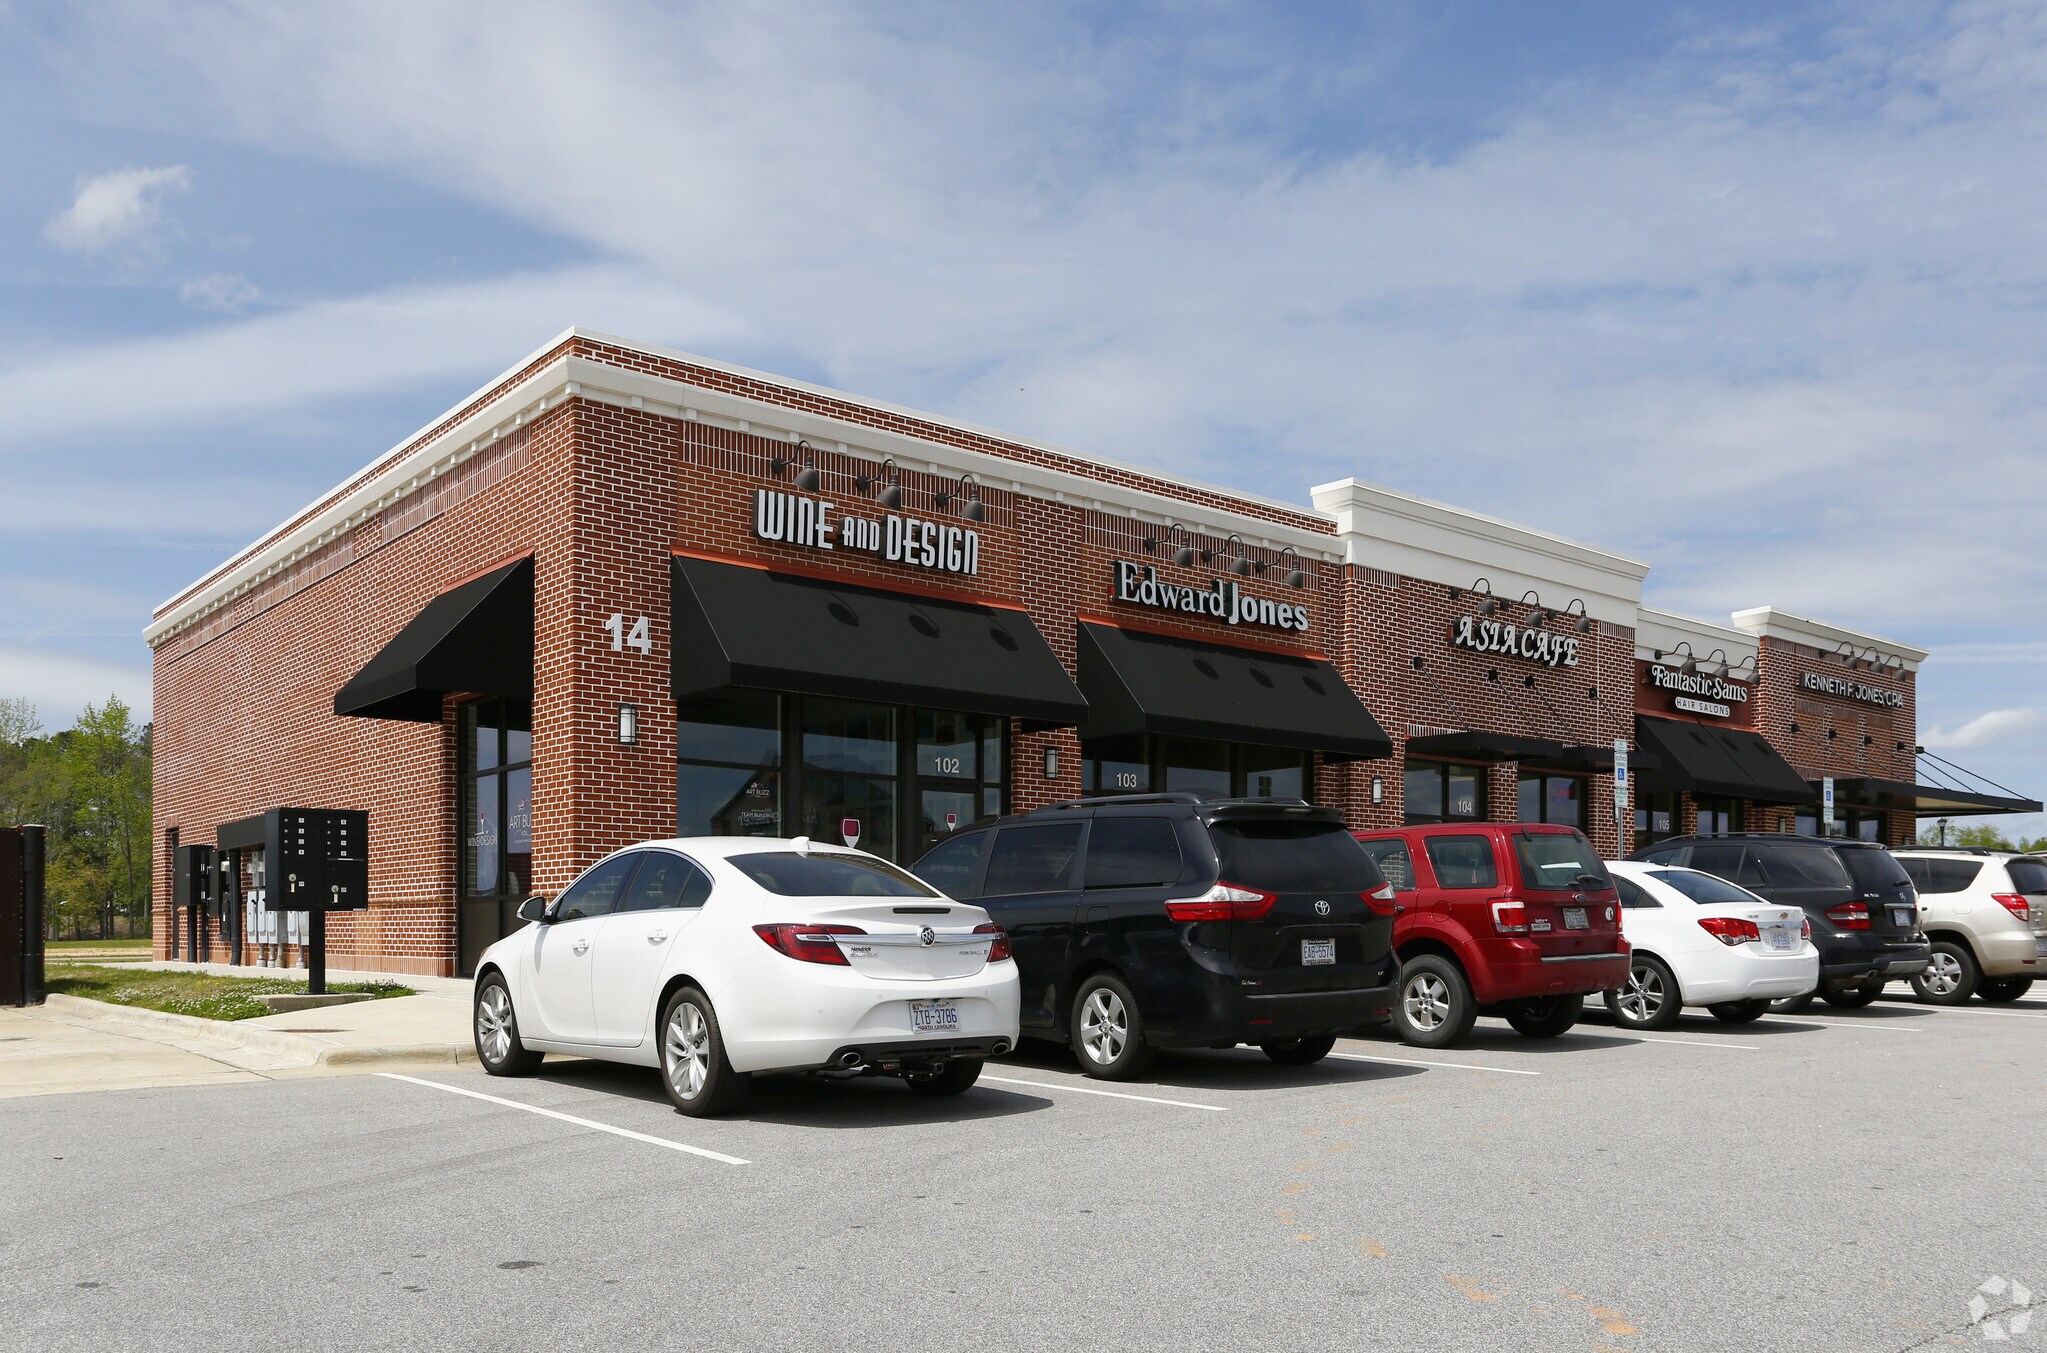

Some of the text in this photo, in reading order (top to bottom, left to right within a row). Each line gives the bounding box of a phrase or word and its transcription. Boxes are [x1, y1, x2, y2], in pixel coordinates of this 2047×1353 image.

[757, 489, 979, 576] WINE AND DESIGN
[1117, 560, 1310, 631] Edward Jones
[605, 613, 652, 655] 14
[1455, 615, 1579, 667] ASIA CAFE
[1651, 664, 1748, 703] Fantastic Sams
[1804, 672, 1846, 696] KENNETH
[1885, 691, 1904, 708] CPA
[1676, 698, 1729, 716] HAIR SALONS
[934, 756, 960, 773] 102
[1116, 772, 1137, 788] 103
[756, 788, 770, 796] BUZZ
[1457, 800, 1473, 813] 104
[509, 814, 522, 829] ART
[1658, 819, 1670, 830] 105
[1304, 945, 1334, 959] EAB-5574
[913, 1008, 958, 1026] ZTB-3786
